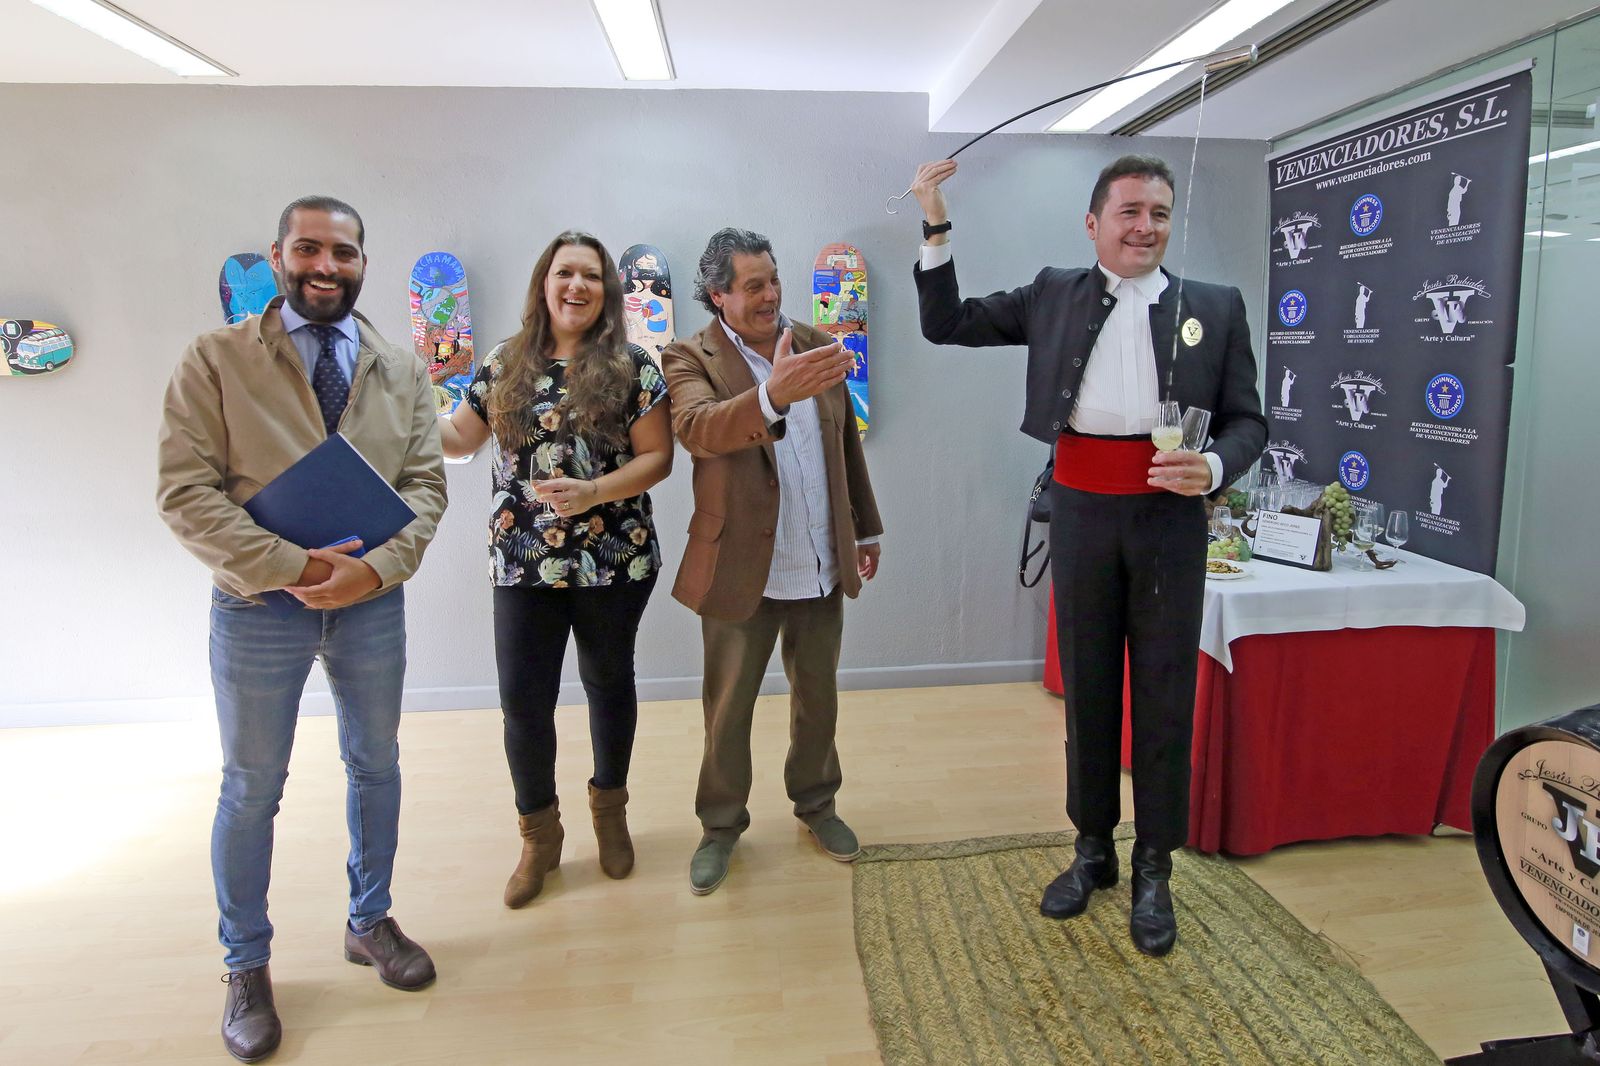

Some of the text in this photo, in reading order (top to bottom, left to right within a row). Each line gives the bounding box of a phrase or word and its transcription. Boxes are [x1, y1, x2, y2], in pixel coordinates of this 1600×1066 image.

[1276, 96, 1508, 184] VENENCIADORES, S.L.
[1315, 151, 1431, 190] www.venenciadores.com
[1431, 222, 1481, 235] VENENCIADORES
[413, 255, 464, 280] PACHAMAMA
[1432, 377, 1459, 390] GUINNESS
[1434, 424, 1462, 432] GUINNESS
[1424, 434, 1470, 444] VENENCIADORES
[1262, 513, 1278, 521] FINO
[1536, 760, 1571, 784] Jesús
[1521, 812, 1548, 830] GRUPO
[1568, 872, 1576, 881] y
